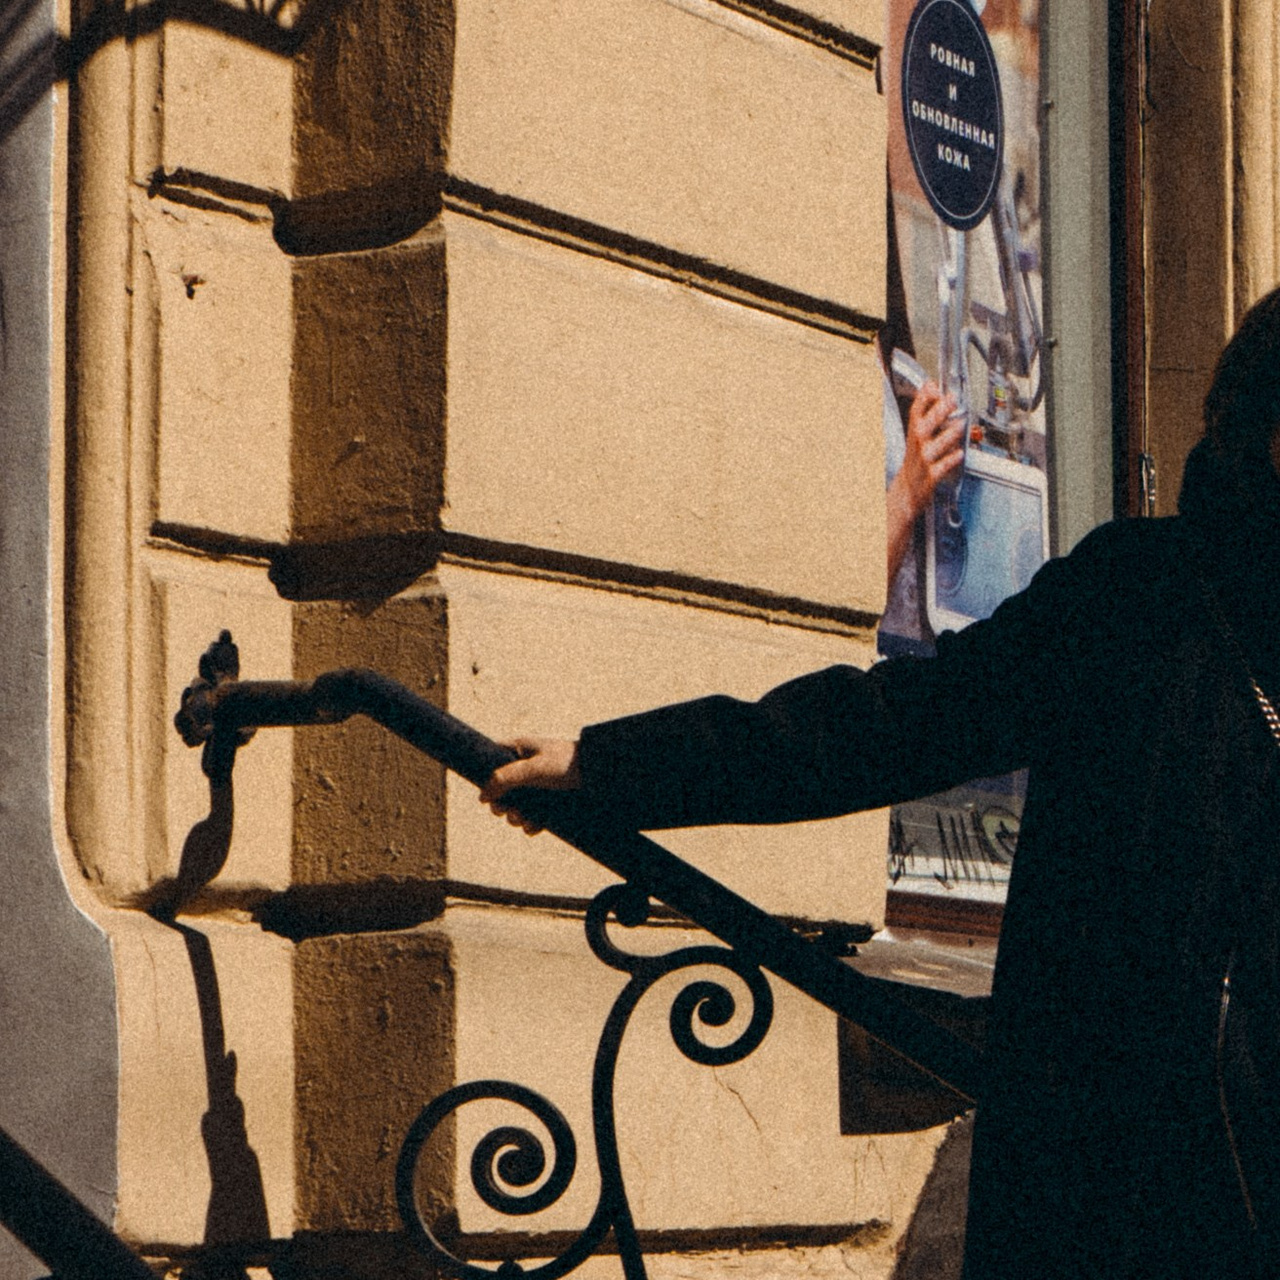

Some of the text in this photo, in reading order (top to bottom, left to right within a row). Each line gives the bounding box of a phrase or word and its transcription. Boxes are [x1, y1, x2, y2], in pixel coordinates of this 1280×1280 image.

[930, 43, 975, 77] РОВНАЯ
[948, 83, 957, 101] И
[912, 100, 995, 150] ОБНОВЛЕННАЯ
[937, 143, 970, 171] КОЖА
